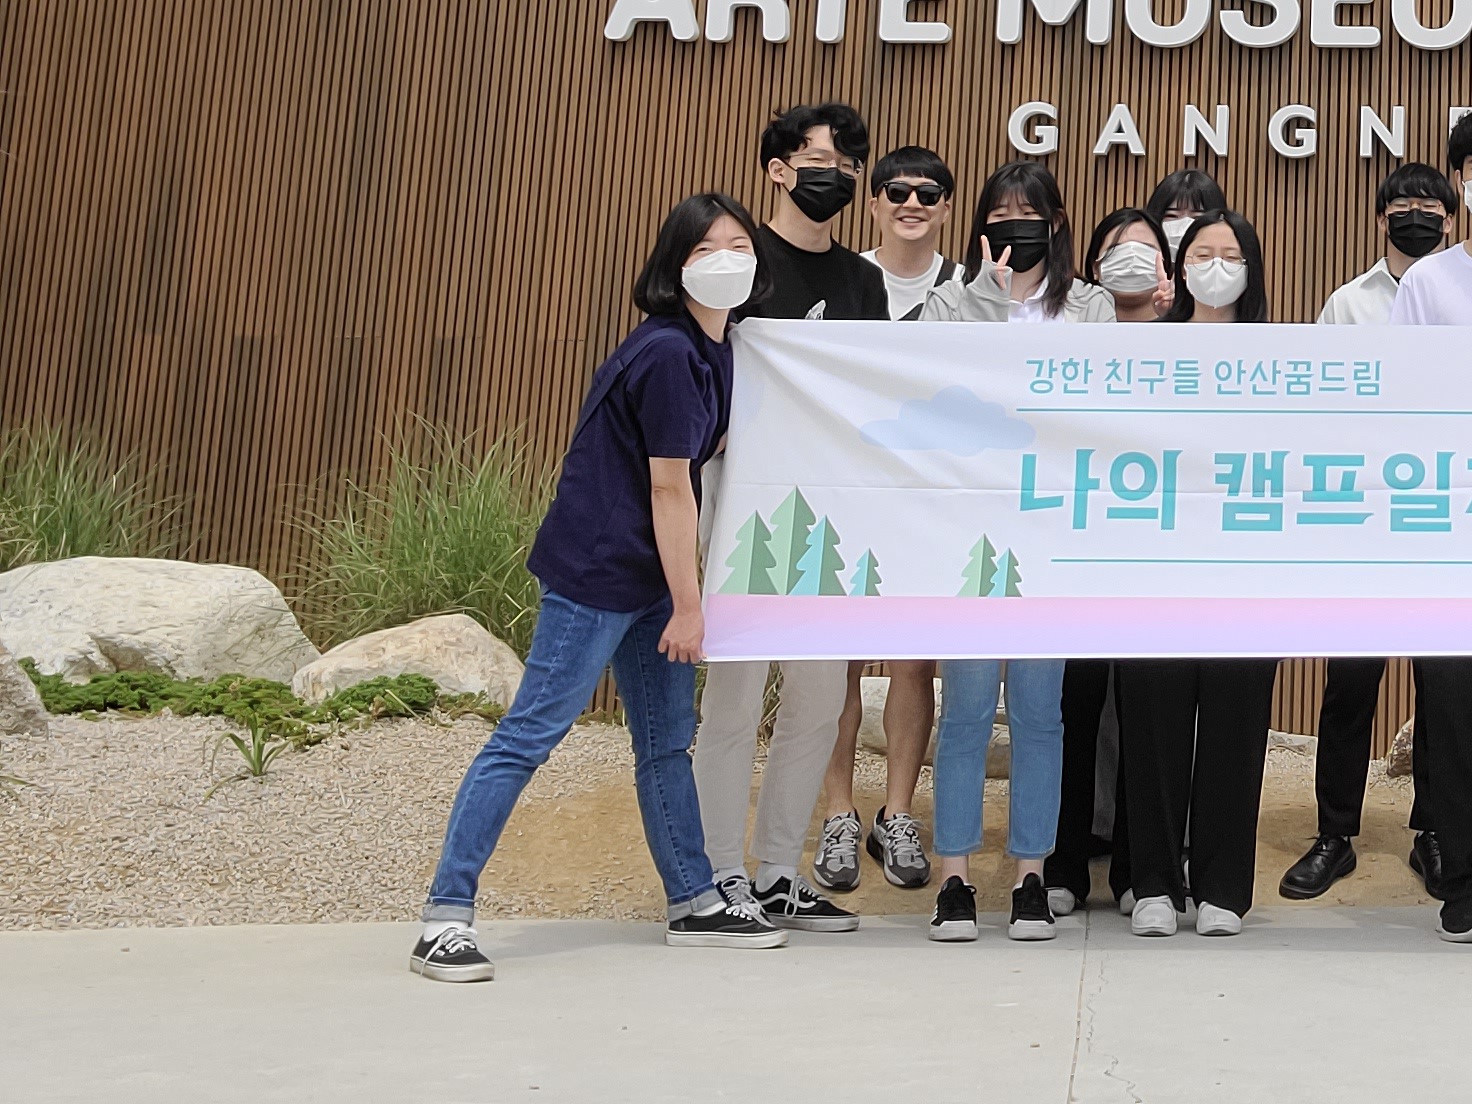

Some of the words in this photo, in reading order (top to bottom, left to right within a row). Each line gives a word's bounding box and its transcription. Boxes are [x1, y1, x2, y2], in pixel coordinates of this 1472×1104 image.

[1025, 357, 1094, 395] 강한
[1103, 357, 1203, 395] 친구들
[1214, 359, 1382, 396] 안산꿈드림
[1019, 449, 1183, 531] 나의
